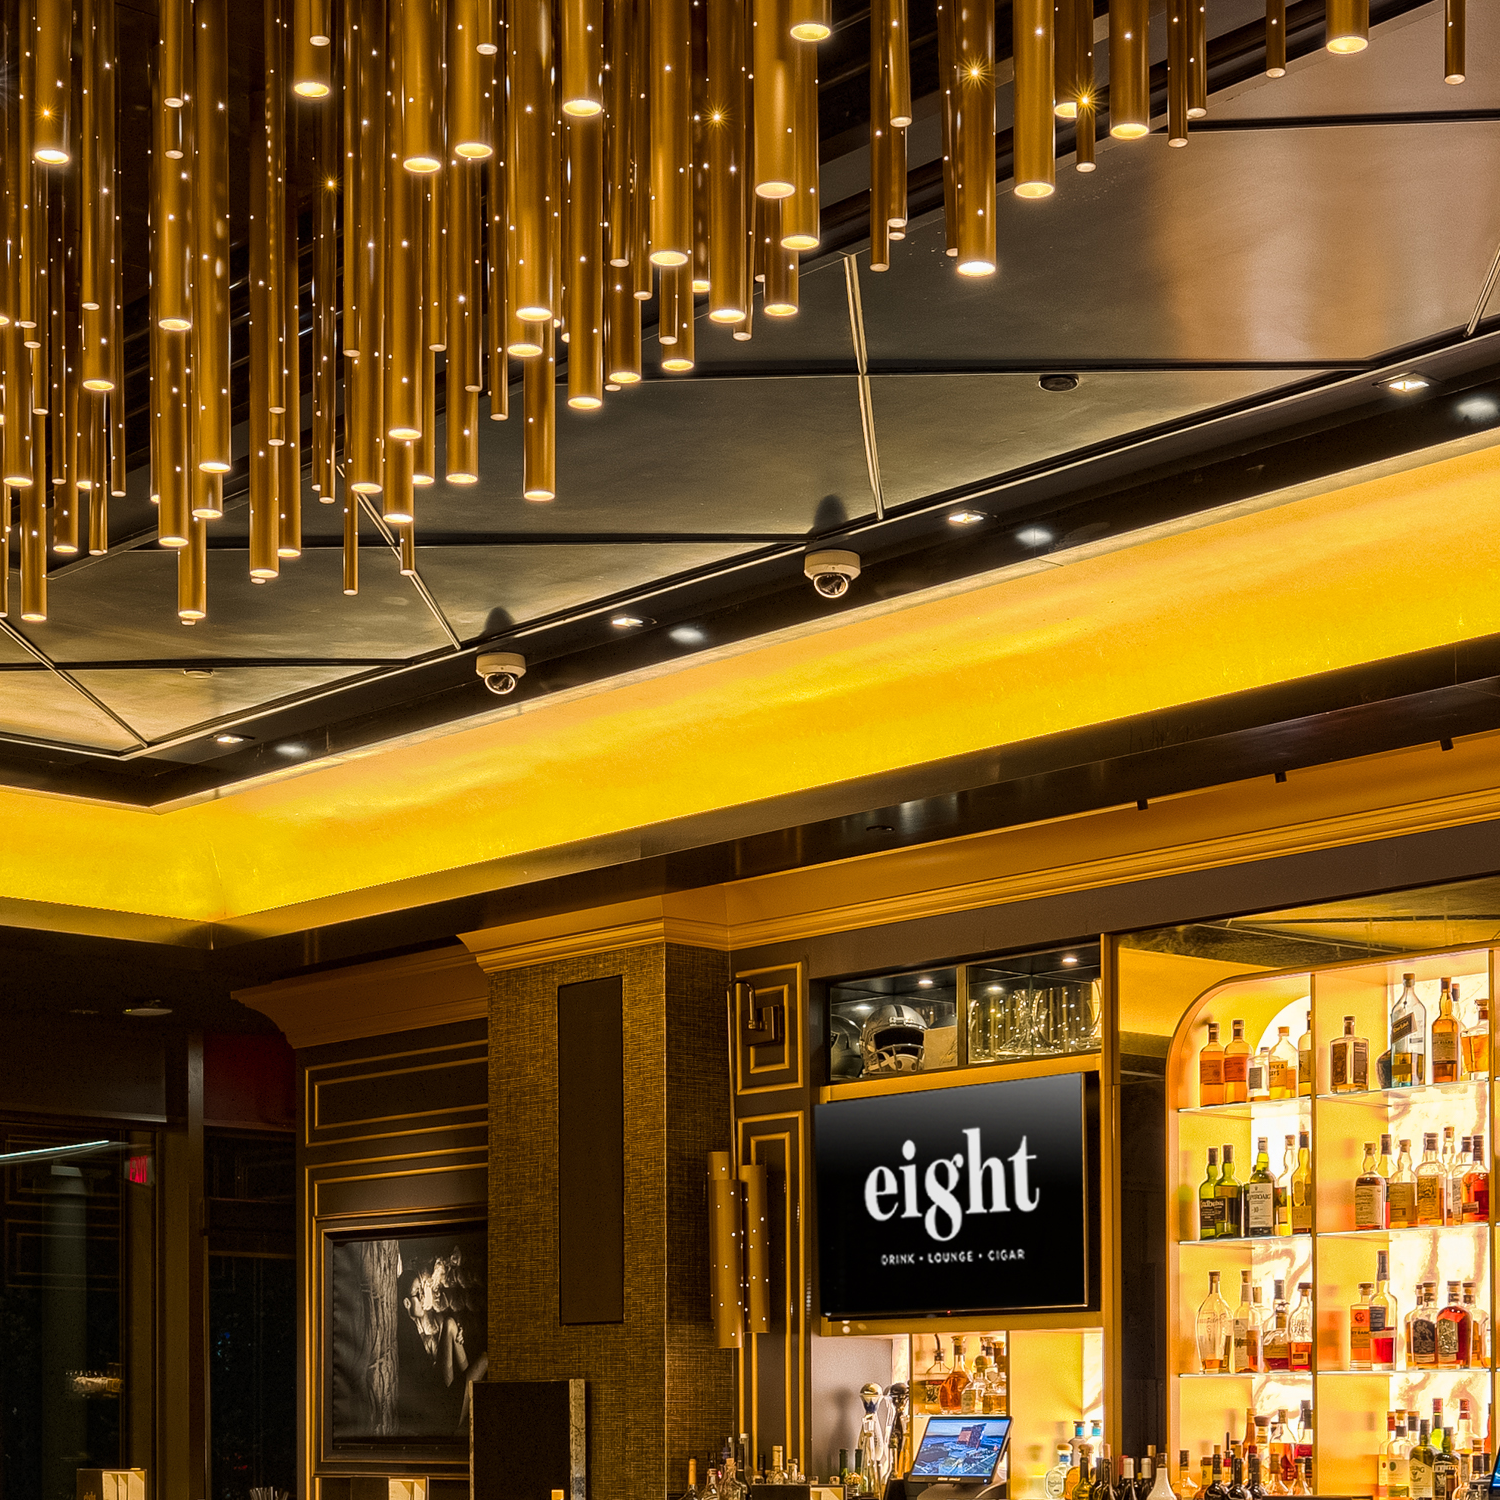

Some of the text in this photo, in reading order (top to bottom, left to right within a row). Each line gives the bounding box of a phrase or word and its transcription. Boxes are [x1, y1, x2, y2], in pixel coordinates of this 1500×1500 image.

[864, 1127, 1040, 1241] eight
[881, 1249, 1025, 1266] DRINK LOUNGE CIGAR
